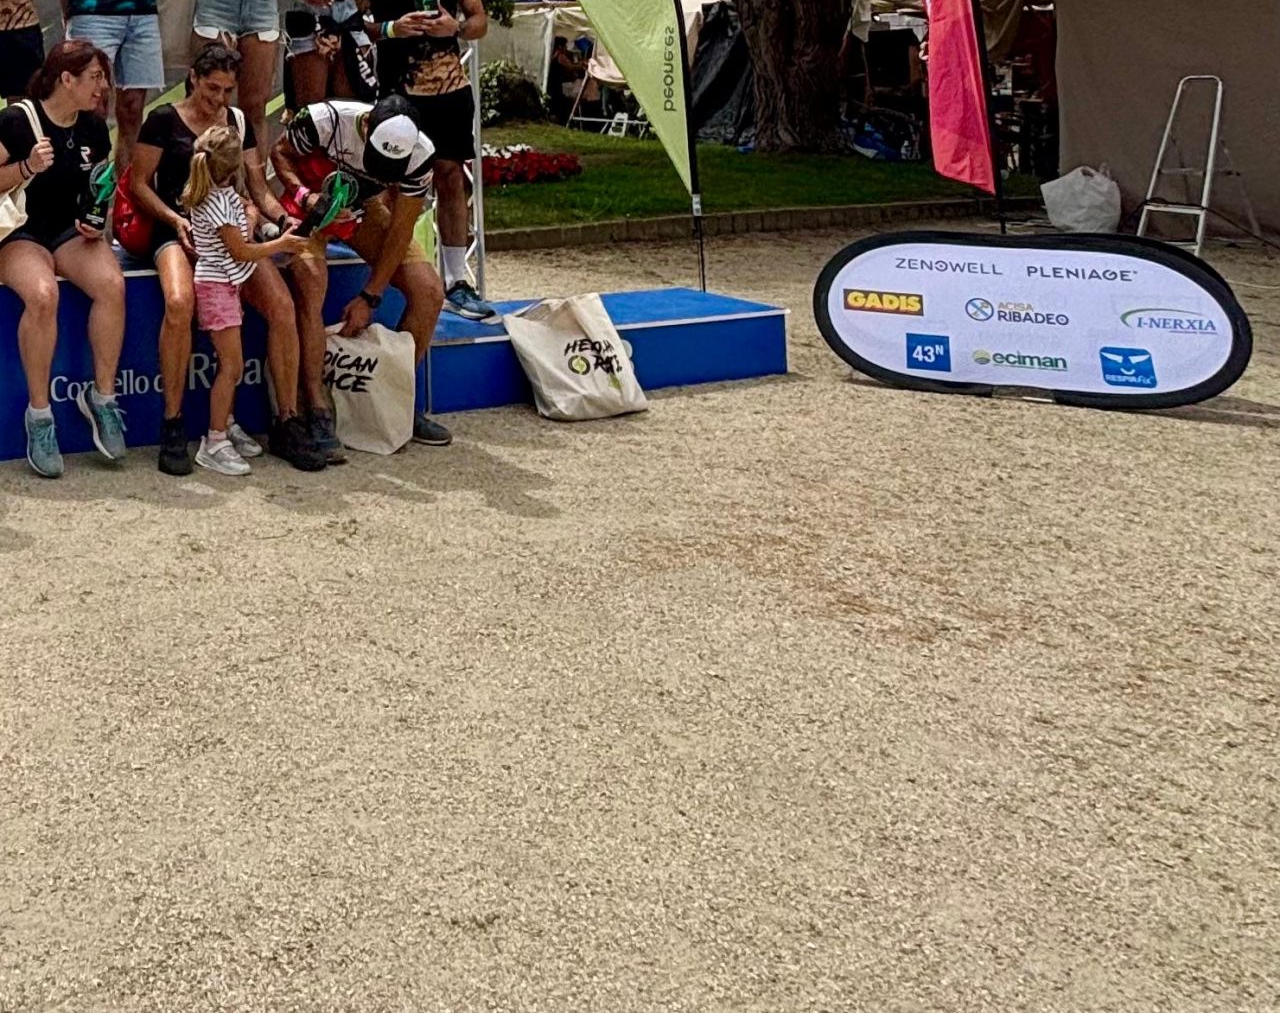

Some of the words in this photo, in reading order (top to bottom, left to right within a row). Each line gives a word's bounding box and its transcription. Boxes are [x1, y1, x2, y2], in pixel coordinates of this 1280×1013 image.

[1026, 265, 1133, 282] PLENIAGE
[846, 291, 922, 313] GADIS
[1136, 316, 1217, 332] I-NERXIA
[992, 349, 1068, 368] eciman
